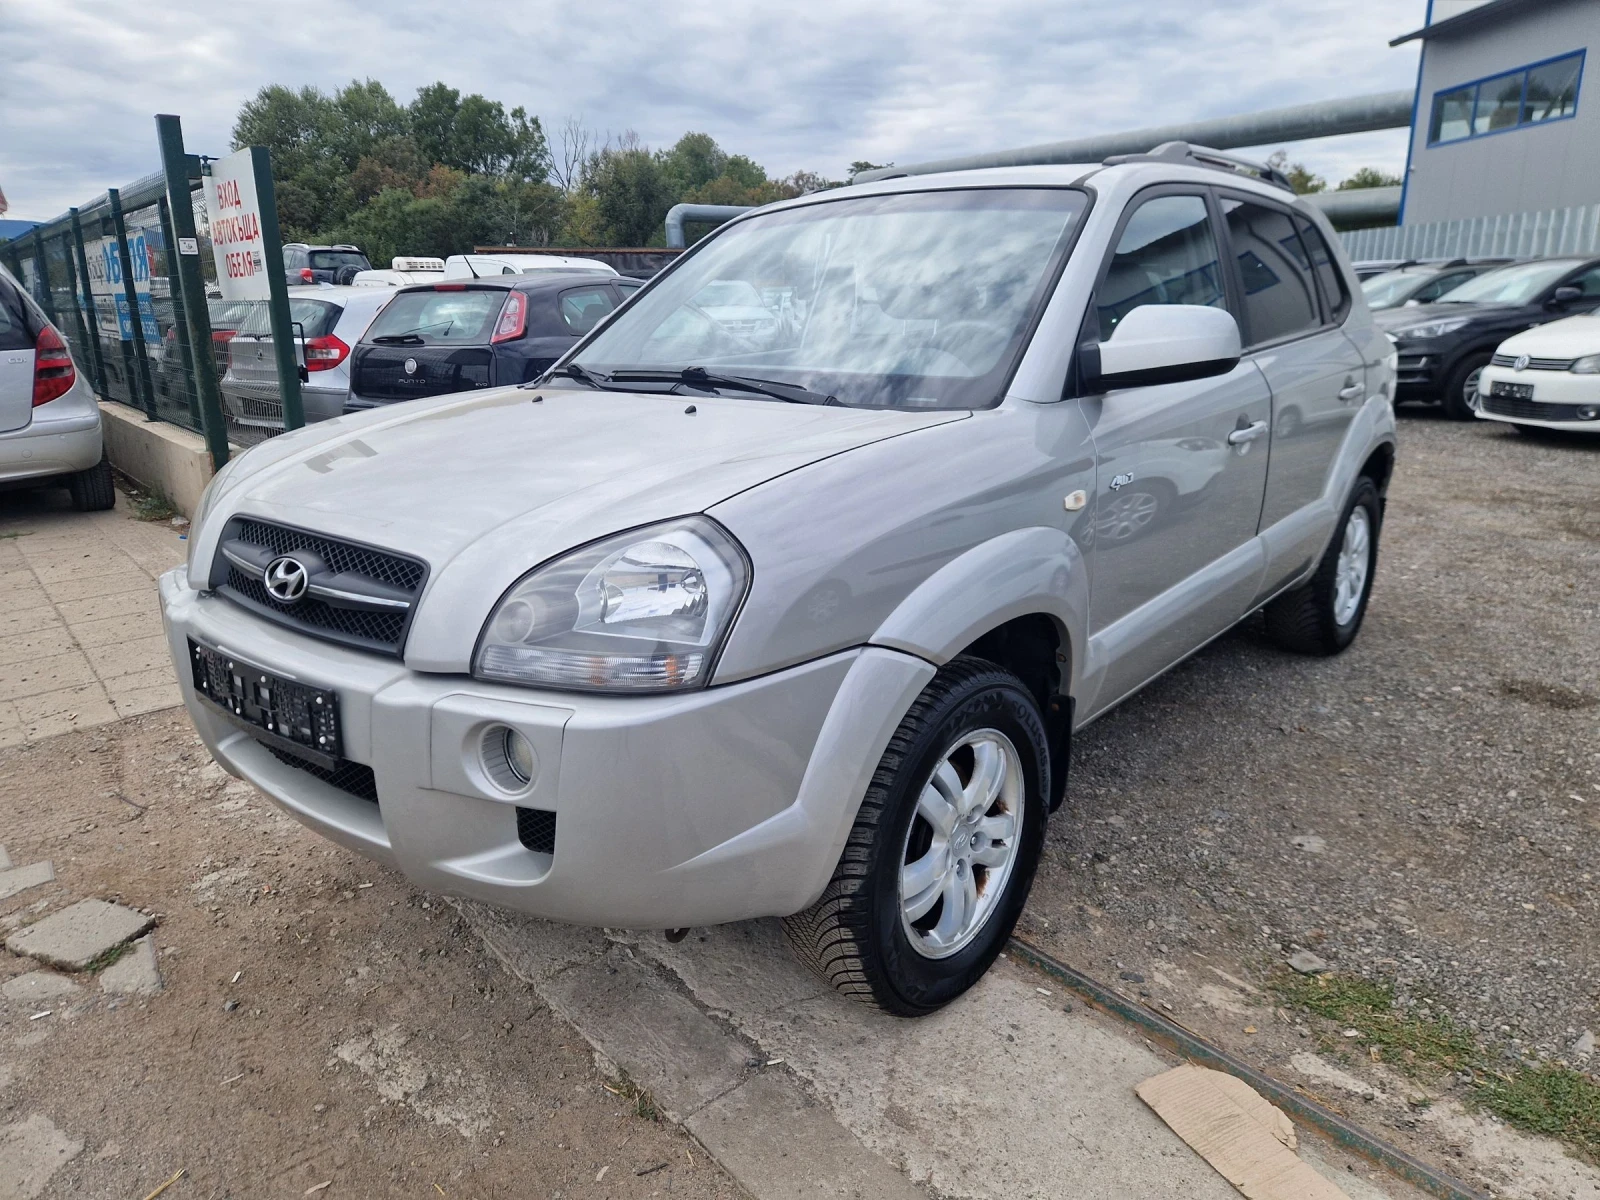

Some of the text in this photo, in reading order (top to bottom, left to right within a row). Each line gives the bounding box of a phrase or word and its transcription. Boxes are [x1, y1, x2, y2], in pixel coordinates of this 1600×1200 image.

[216, 179, 242, 210] ВХОД
[211, 212, 260, 247] АВТОКЪЩА
[225, 250, 255, 279] ОБЕЛЯ
[1011, 700, 1045, 747] SOLUS
